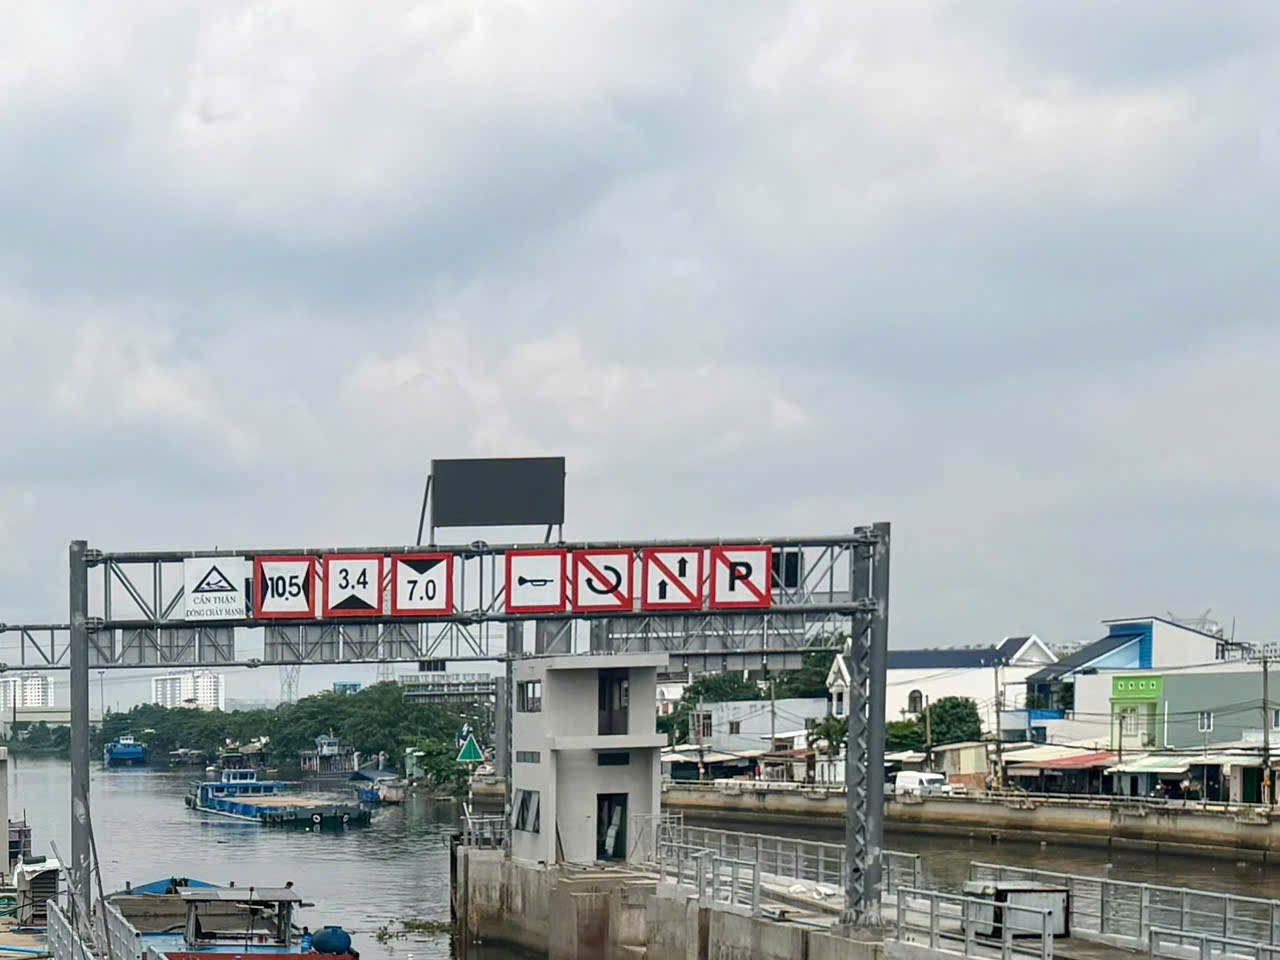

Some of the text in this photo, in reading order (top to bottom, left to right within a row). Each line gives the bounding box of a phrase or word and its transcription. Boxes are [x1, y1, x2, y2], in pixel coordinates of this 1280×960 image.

[268, 574, 302, 601] 10.5
[338, 567, 369, 590] 3.4
[728, 561, 753, 592] P
[406, 579, 437, 601] 7.0
